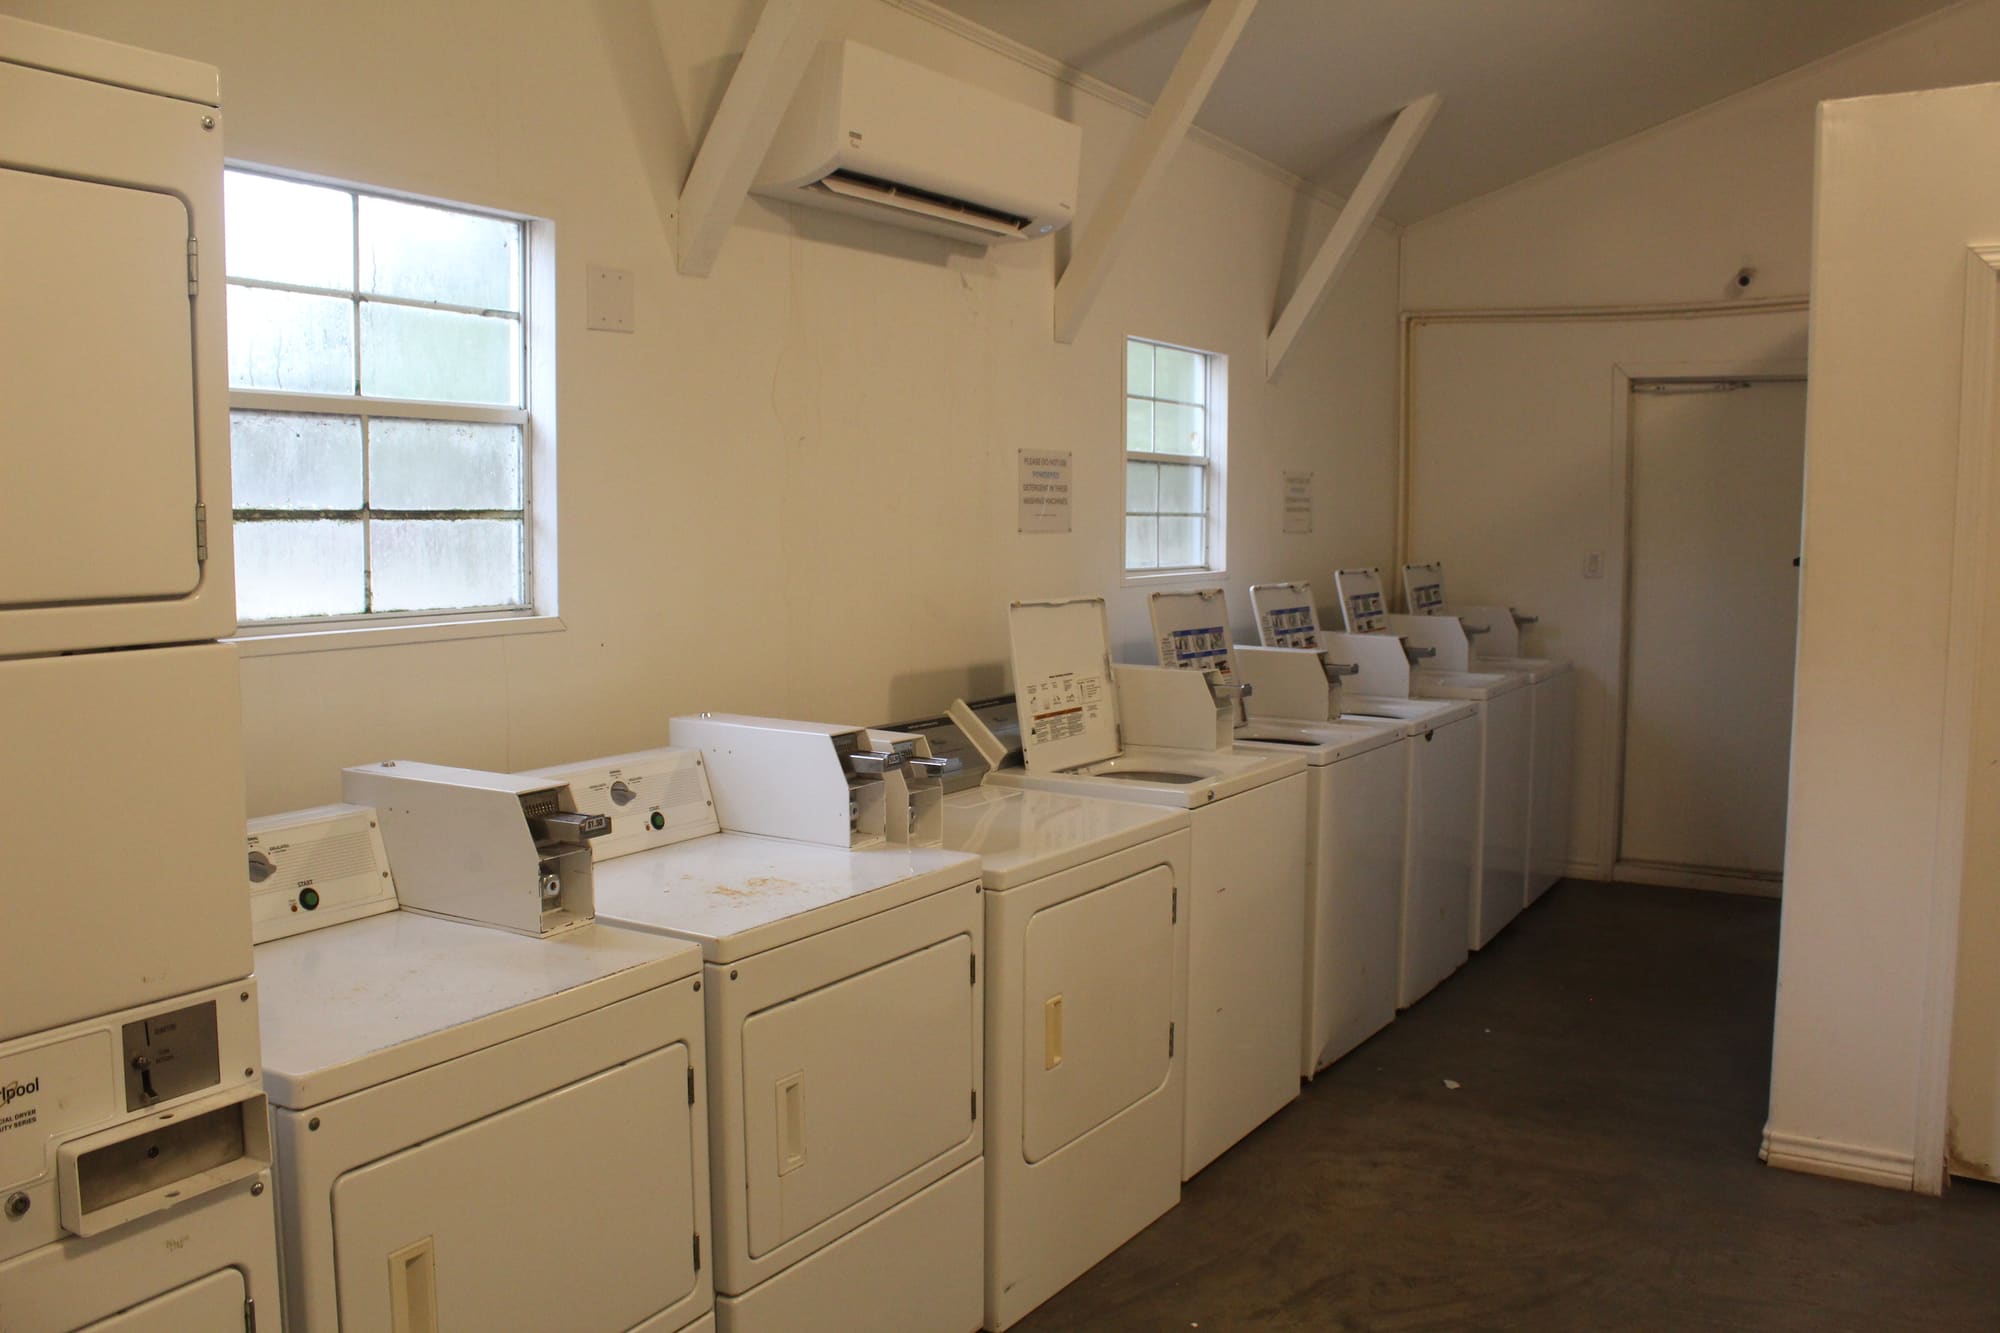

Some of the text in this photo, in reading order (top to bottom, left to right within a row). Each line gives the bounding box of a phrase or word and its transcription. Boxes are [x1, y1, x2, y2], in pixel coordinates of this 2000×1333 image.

[0, 1077, 39, 1105] lpool
[14, 1108, 36, 1121] DRYER
[13, 1116, 37, 1129] SERIES
